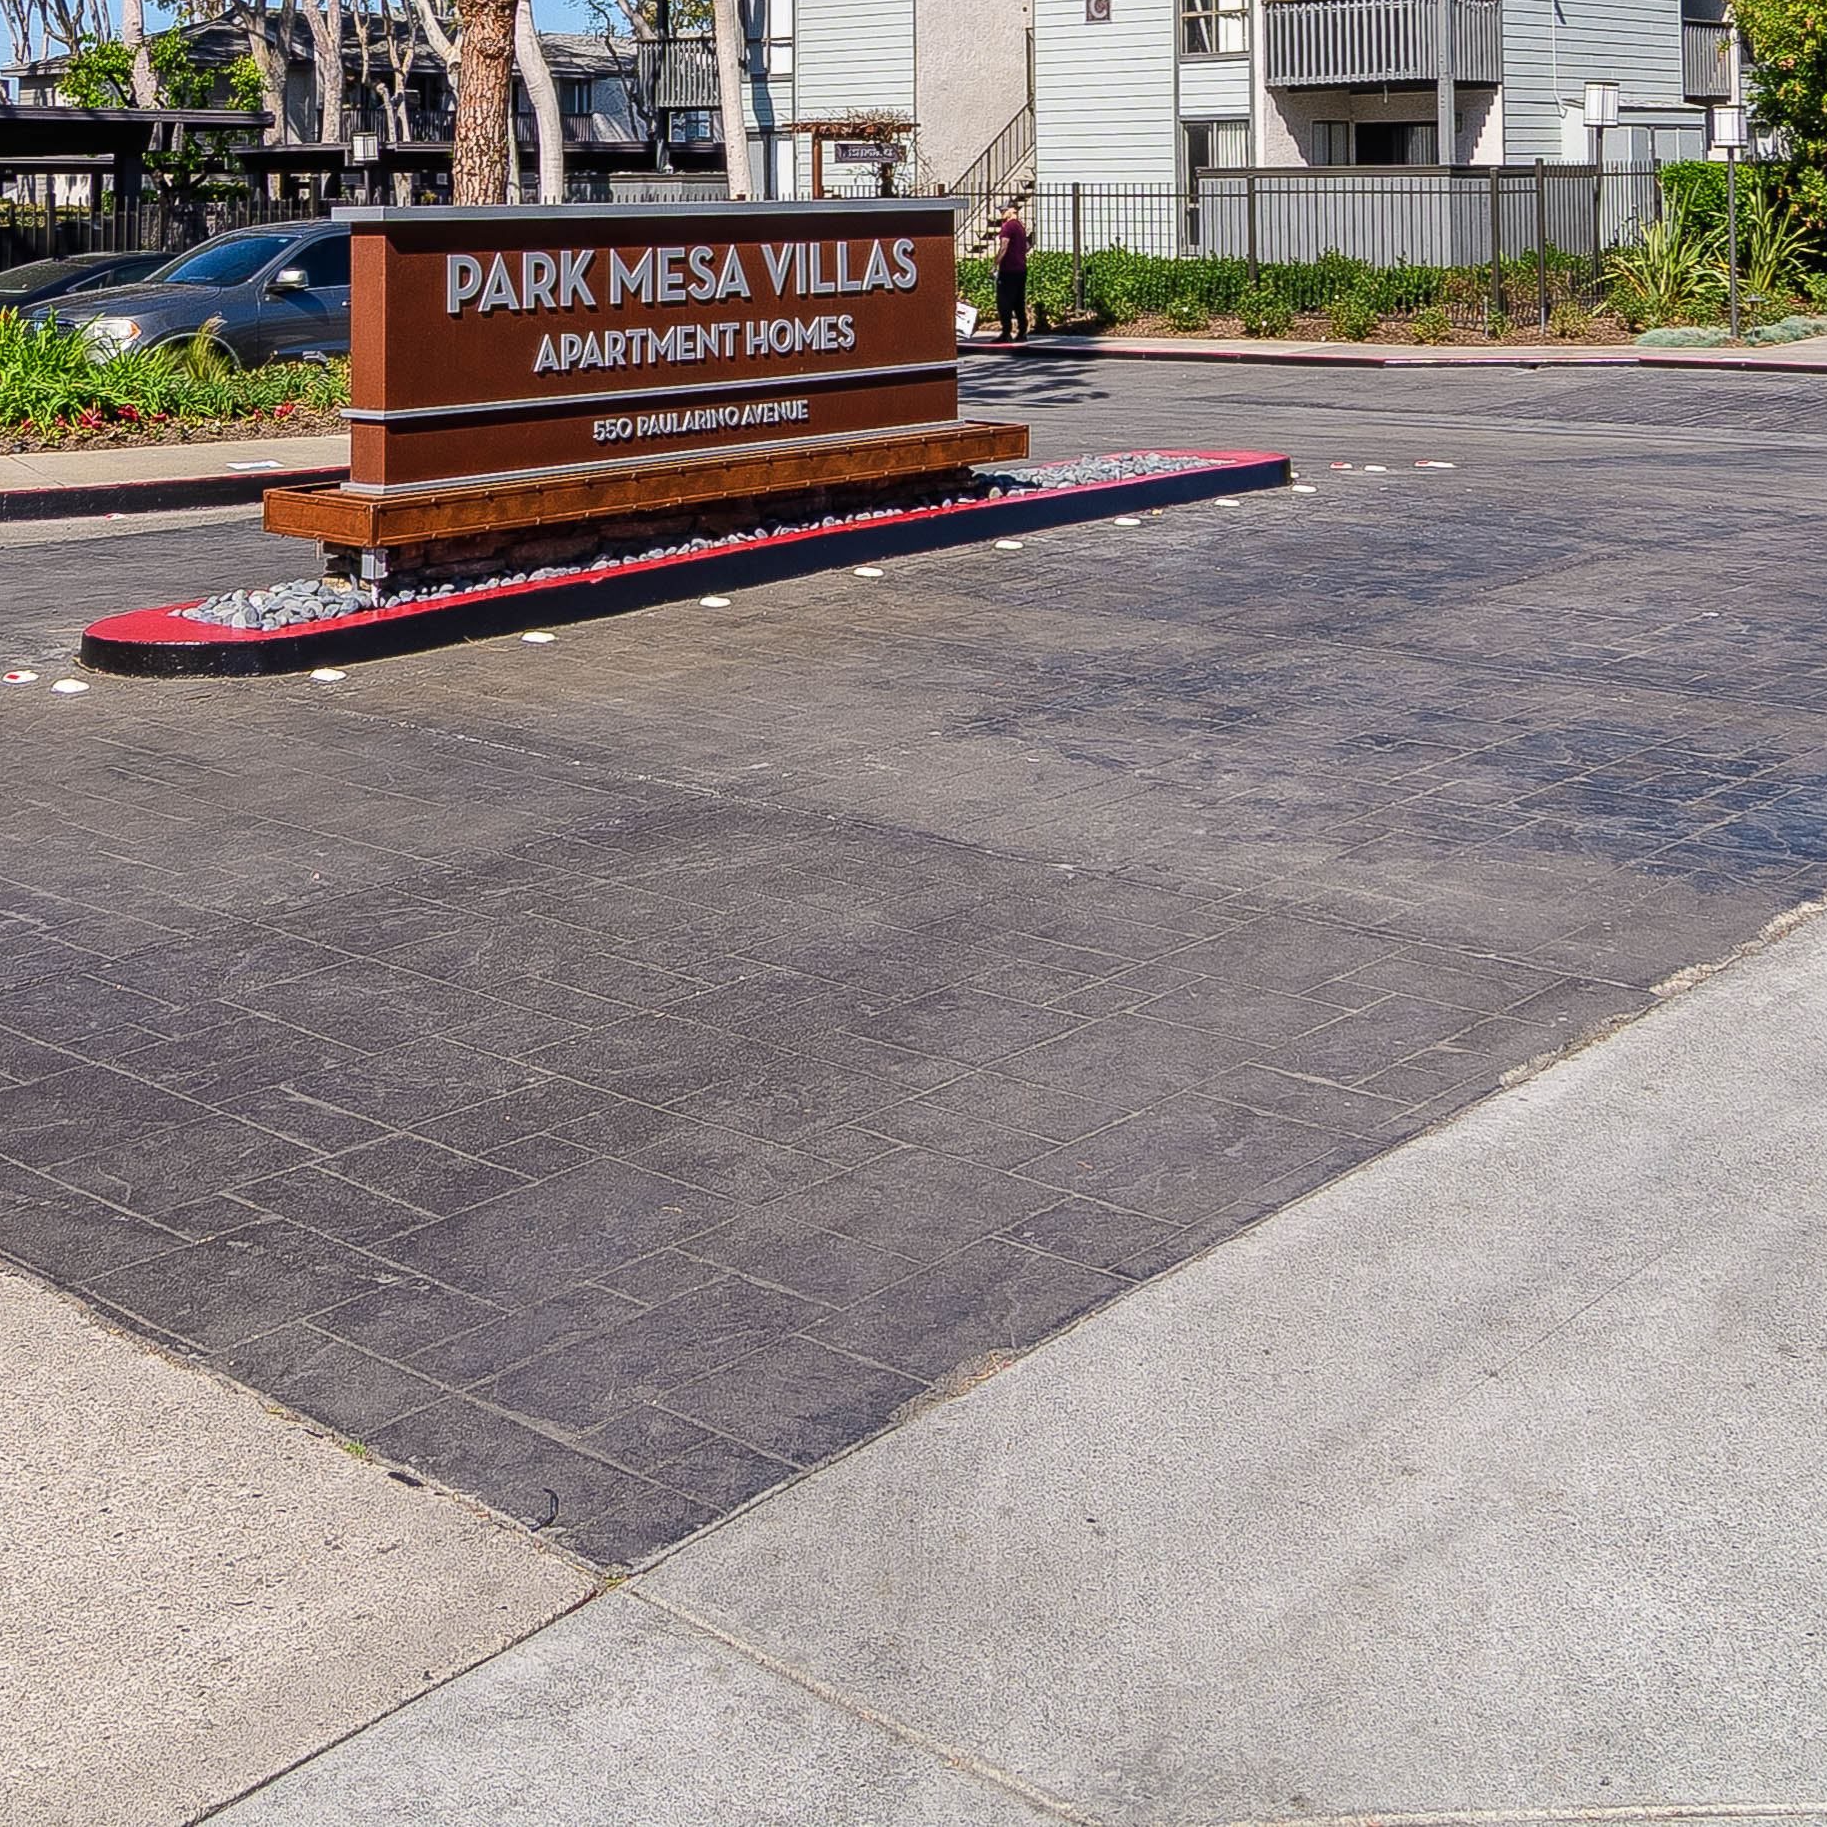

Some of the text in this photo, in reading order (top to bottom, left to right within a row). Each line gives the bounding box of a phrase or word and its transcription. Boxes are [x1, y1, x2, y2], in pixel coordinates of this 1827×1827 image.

[446, 237, 918, 314] PARK MESA VILLAS
[532, 314, 856, 373] APARTMENT HOMES
[592, 399, 809, 441] 550 PAULARINO AVENUE
